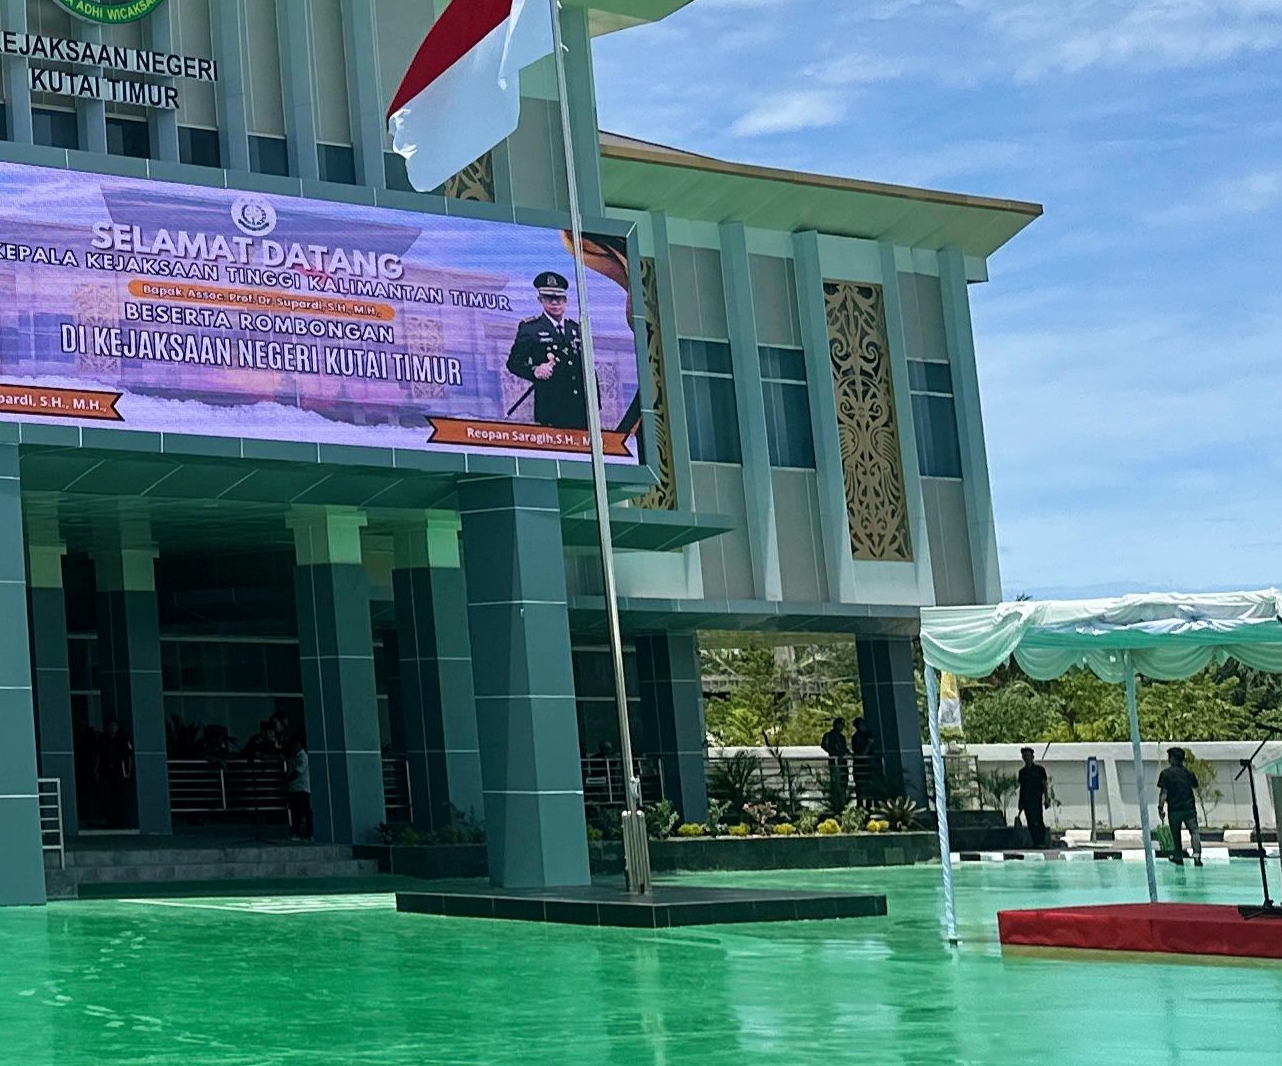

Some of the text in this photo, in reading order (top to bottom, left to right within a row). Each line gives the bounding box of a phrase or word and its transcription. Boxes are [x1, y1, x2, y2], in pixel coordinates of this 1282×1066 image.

[76, 1, 103, 18] ADHI
[135, 49, 218, 82] NEGERI
[29, 67, 180, 109] KUTAI TIMUR
[91, 220, 405, 280] SELAMAT DATANG
[85, 251, 219, 282] KEJAKSAAN
[226, 267, 301, 289] TINGGI
[308, 274, 444, 304] KALIMANTAN
[449, 289, 514, 312] TIMUR
[142, 284, 182, 297] Bapak
[125, 302, 395, 345] BESERTA ROMBONGAN
[61, 323, 463, 386] DI KEJAKSAAN NEGERI KUTAI TIMUR
[466, 427, 510, 442] Reopan
[1089, 759, 1098, 787] P
